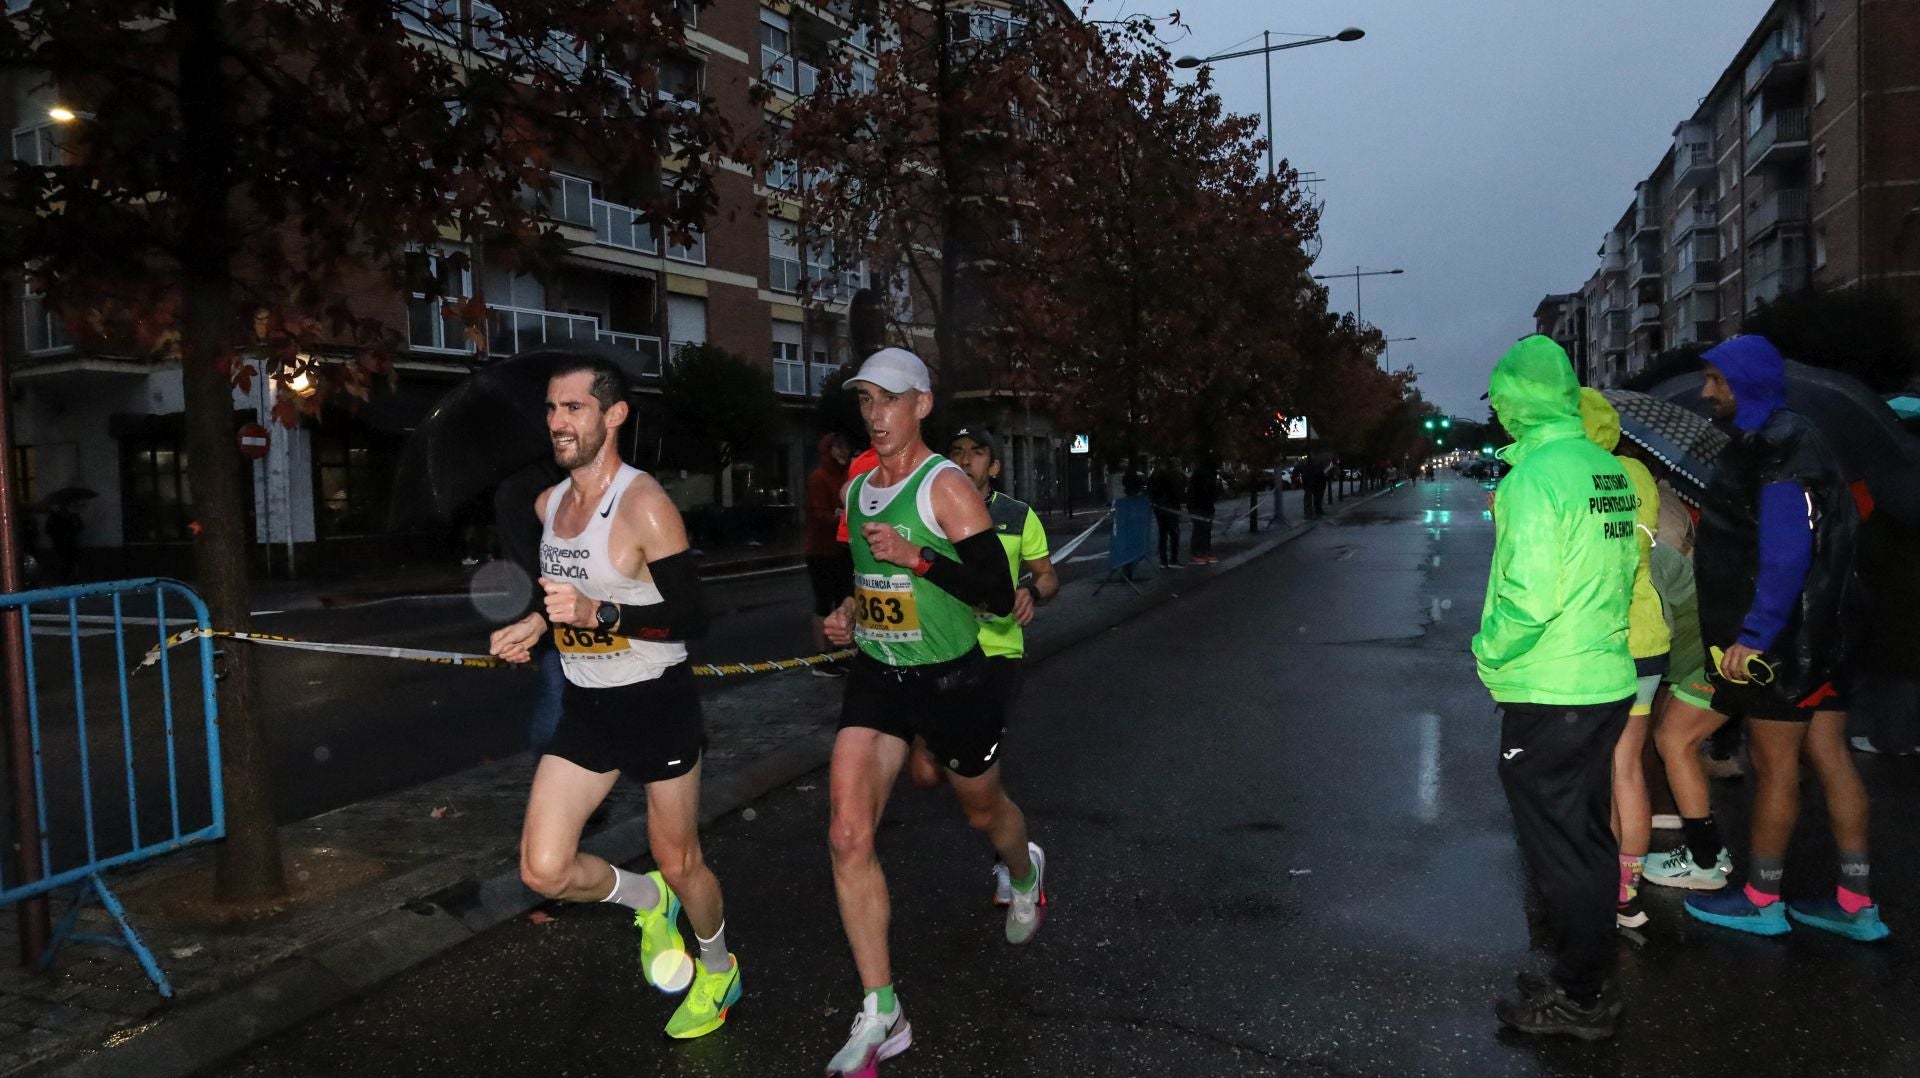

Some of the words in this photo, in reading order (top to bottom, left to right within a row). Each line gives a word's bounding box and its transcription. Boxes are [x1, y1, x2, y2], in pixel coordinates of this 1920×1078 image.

[1592, 474, 1628, 490] ATLETISMO
[1604, 521, 1633, 539] PALENCIA
[857, 594, 904, 624] 363
[561, 627, 615, 648] 364
